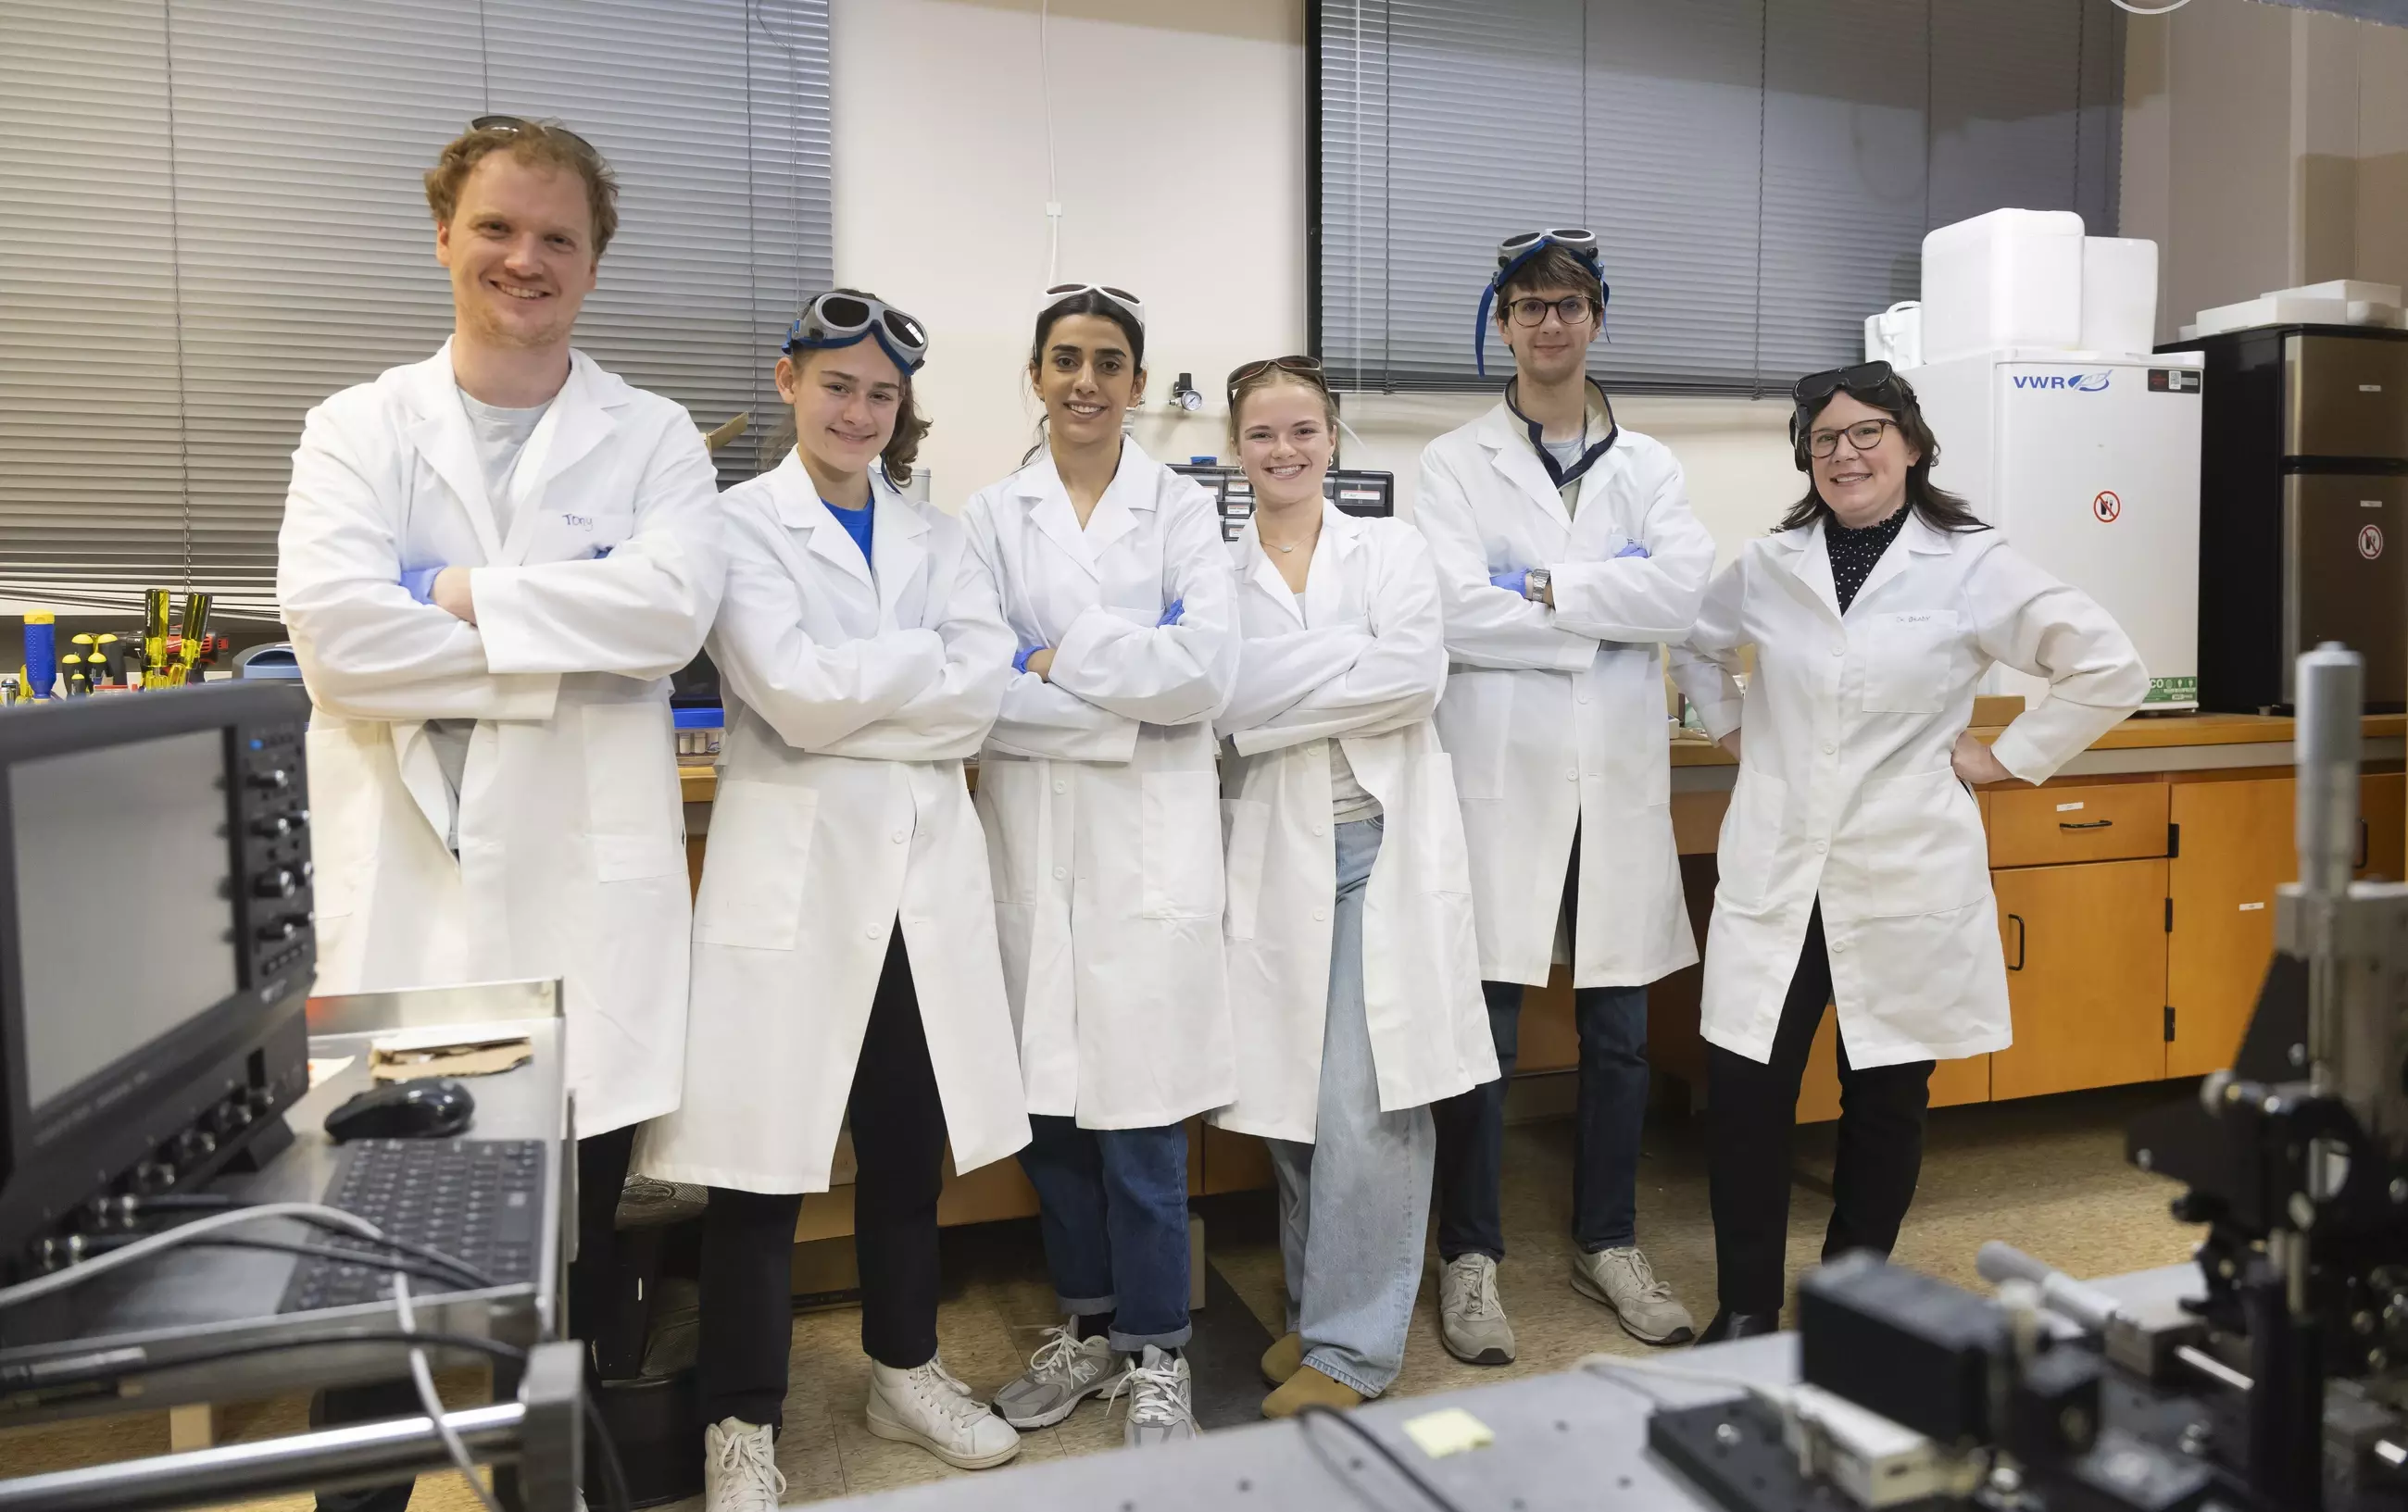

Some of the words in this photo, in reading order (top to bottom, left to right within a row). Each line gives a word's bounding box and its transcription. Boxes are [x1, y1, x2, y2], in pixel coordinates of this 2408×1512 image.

[2013, 376, 2065, 389] VWR
[562, 513, 594, 532] Tony
[2150, 679, 2163, 689] CO
